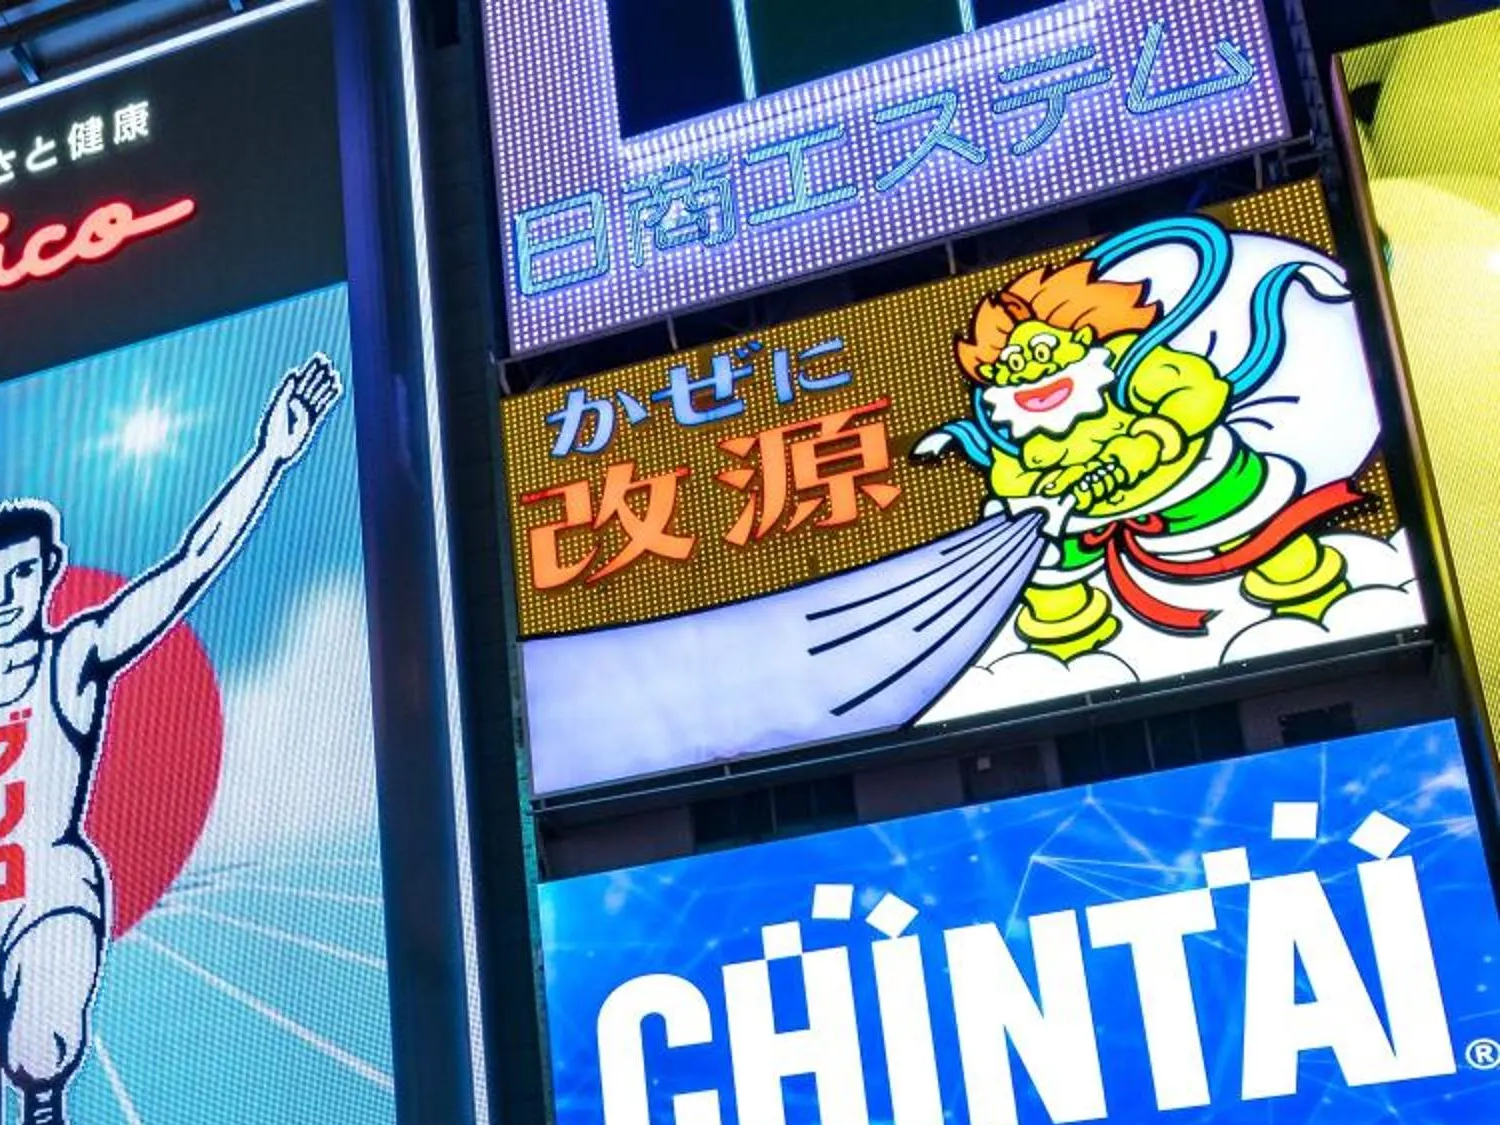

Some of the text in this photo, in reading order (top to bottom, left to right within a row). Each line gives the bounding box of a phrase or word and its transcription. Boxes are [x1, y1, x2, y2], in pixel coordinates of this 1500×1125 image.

[513, 20, 1254, 298] 日商エステム
[521, 398, 901, 591] 改源
[546, 337, 853, 459] かぜに
